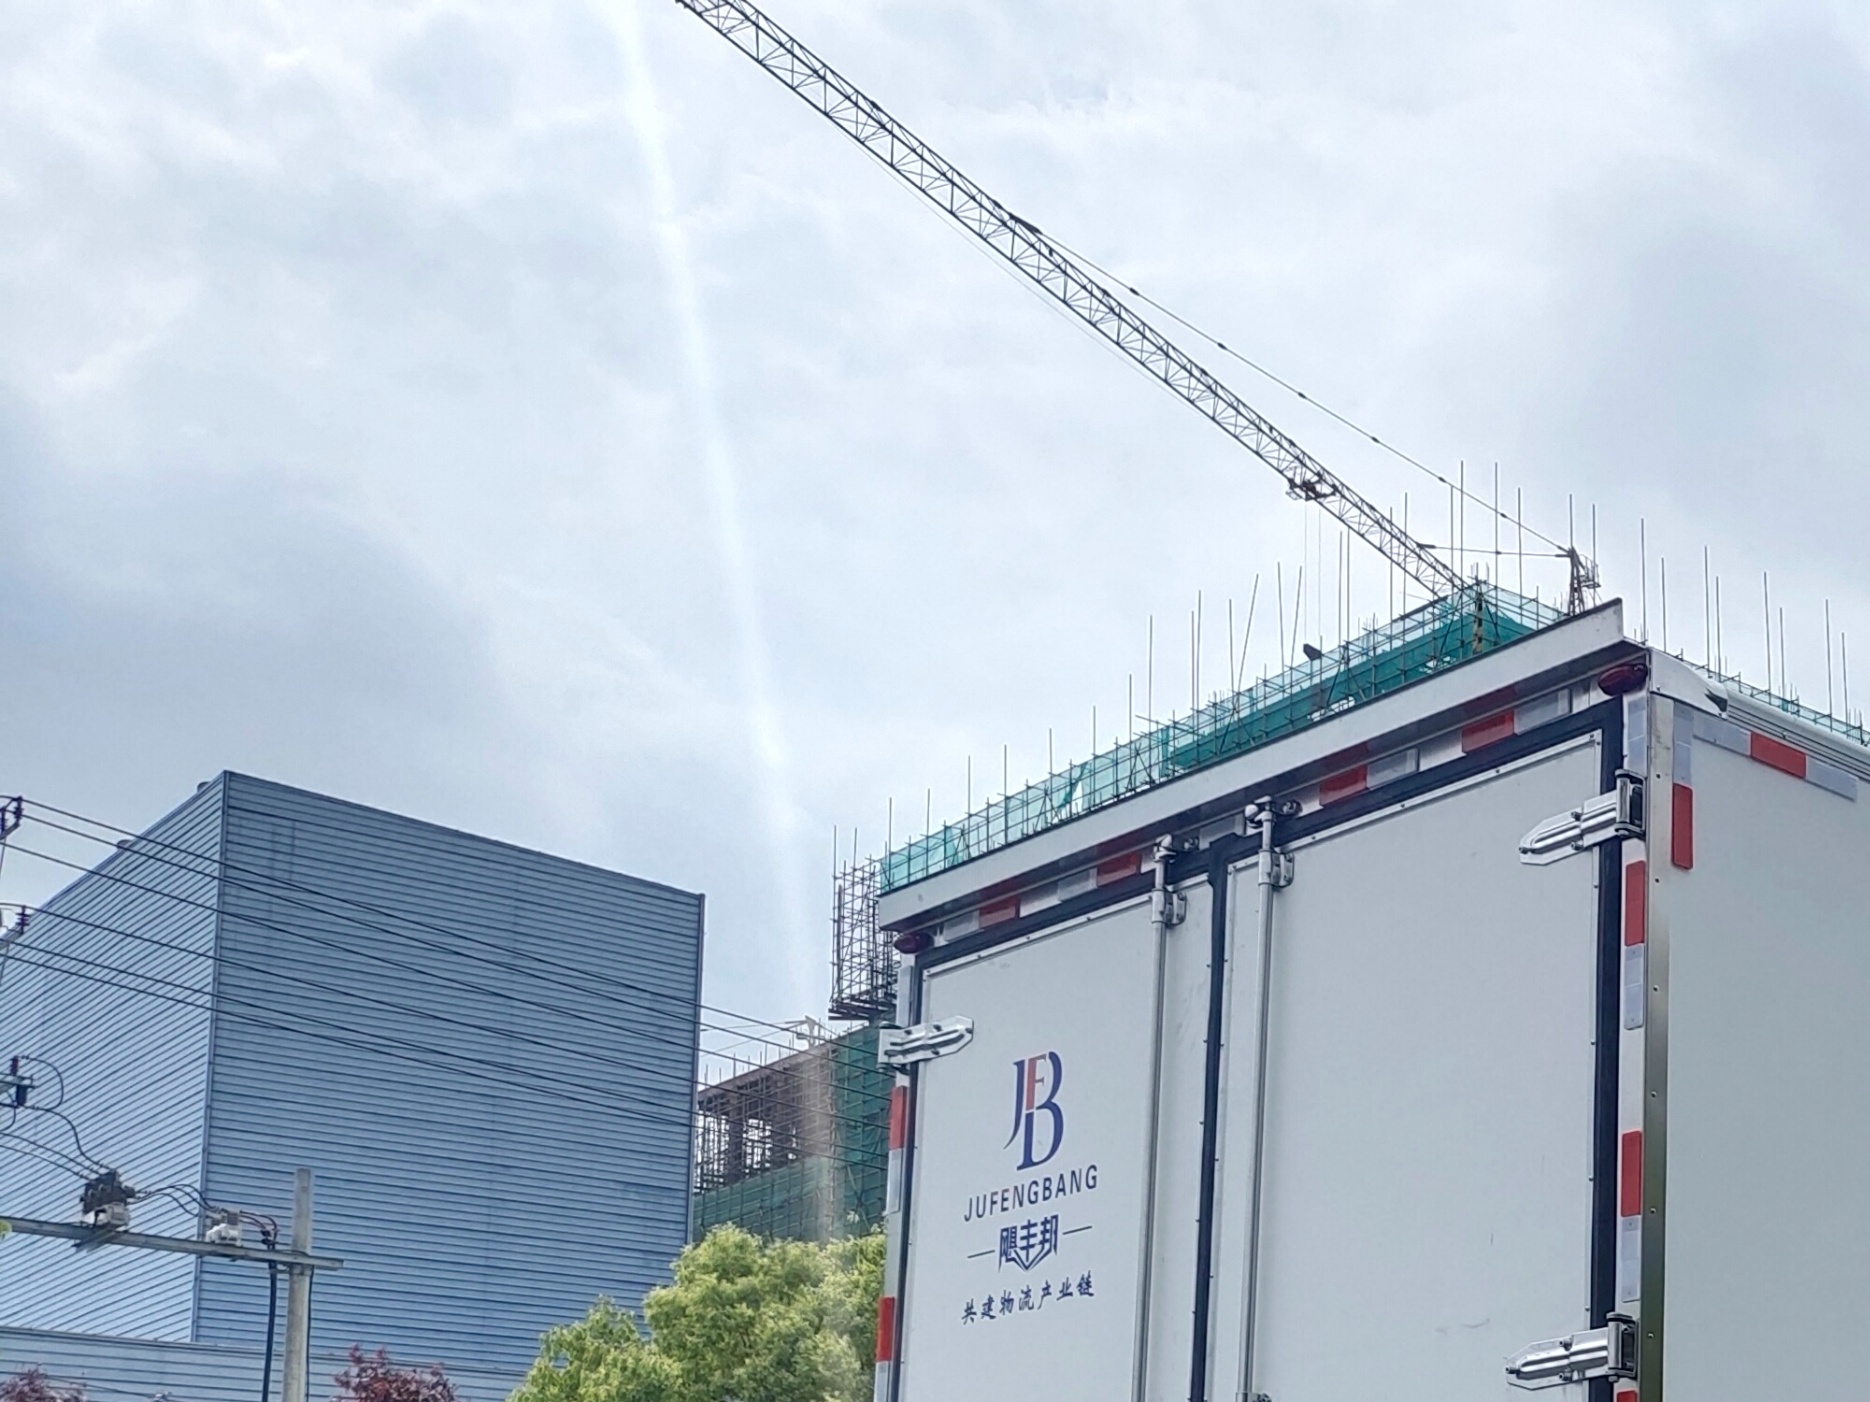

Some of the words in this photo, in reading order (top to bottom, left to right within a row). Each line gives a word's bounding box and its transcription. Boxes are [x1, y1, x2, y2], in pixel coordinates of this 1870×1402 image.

[964, 1164, 1098, 1222] JUFENGBANG
[961, 1270, 1095, 1325] 共建物流产业链
